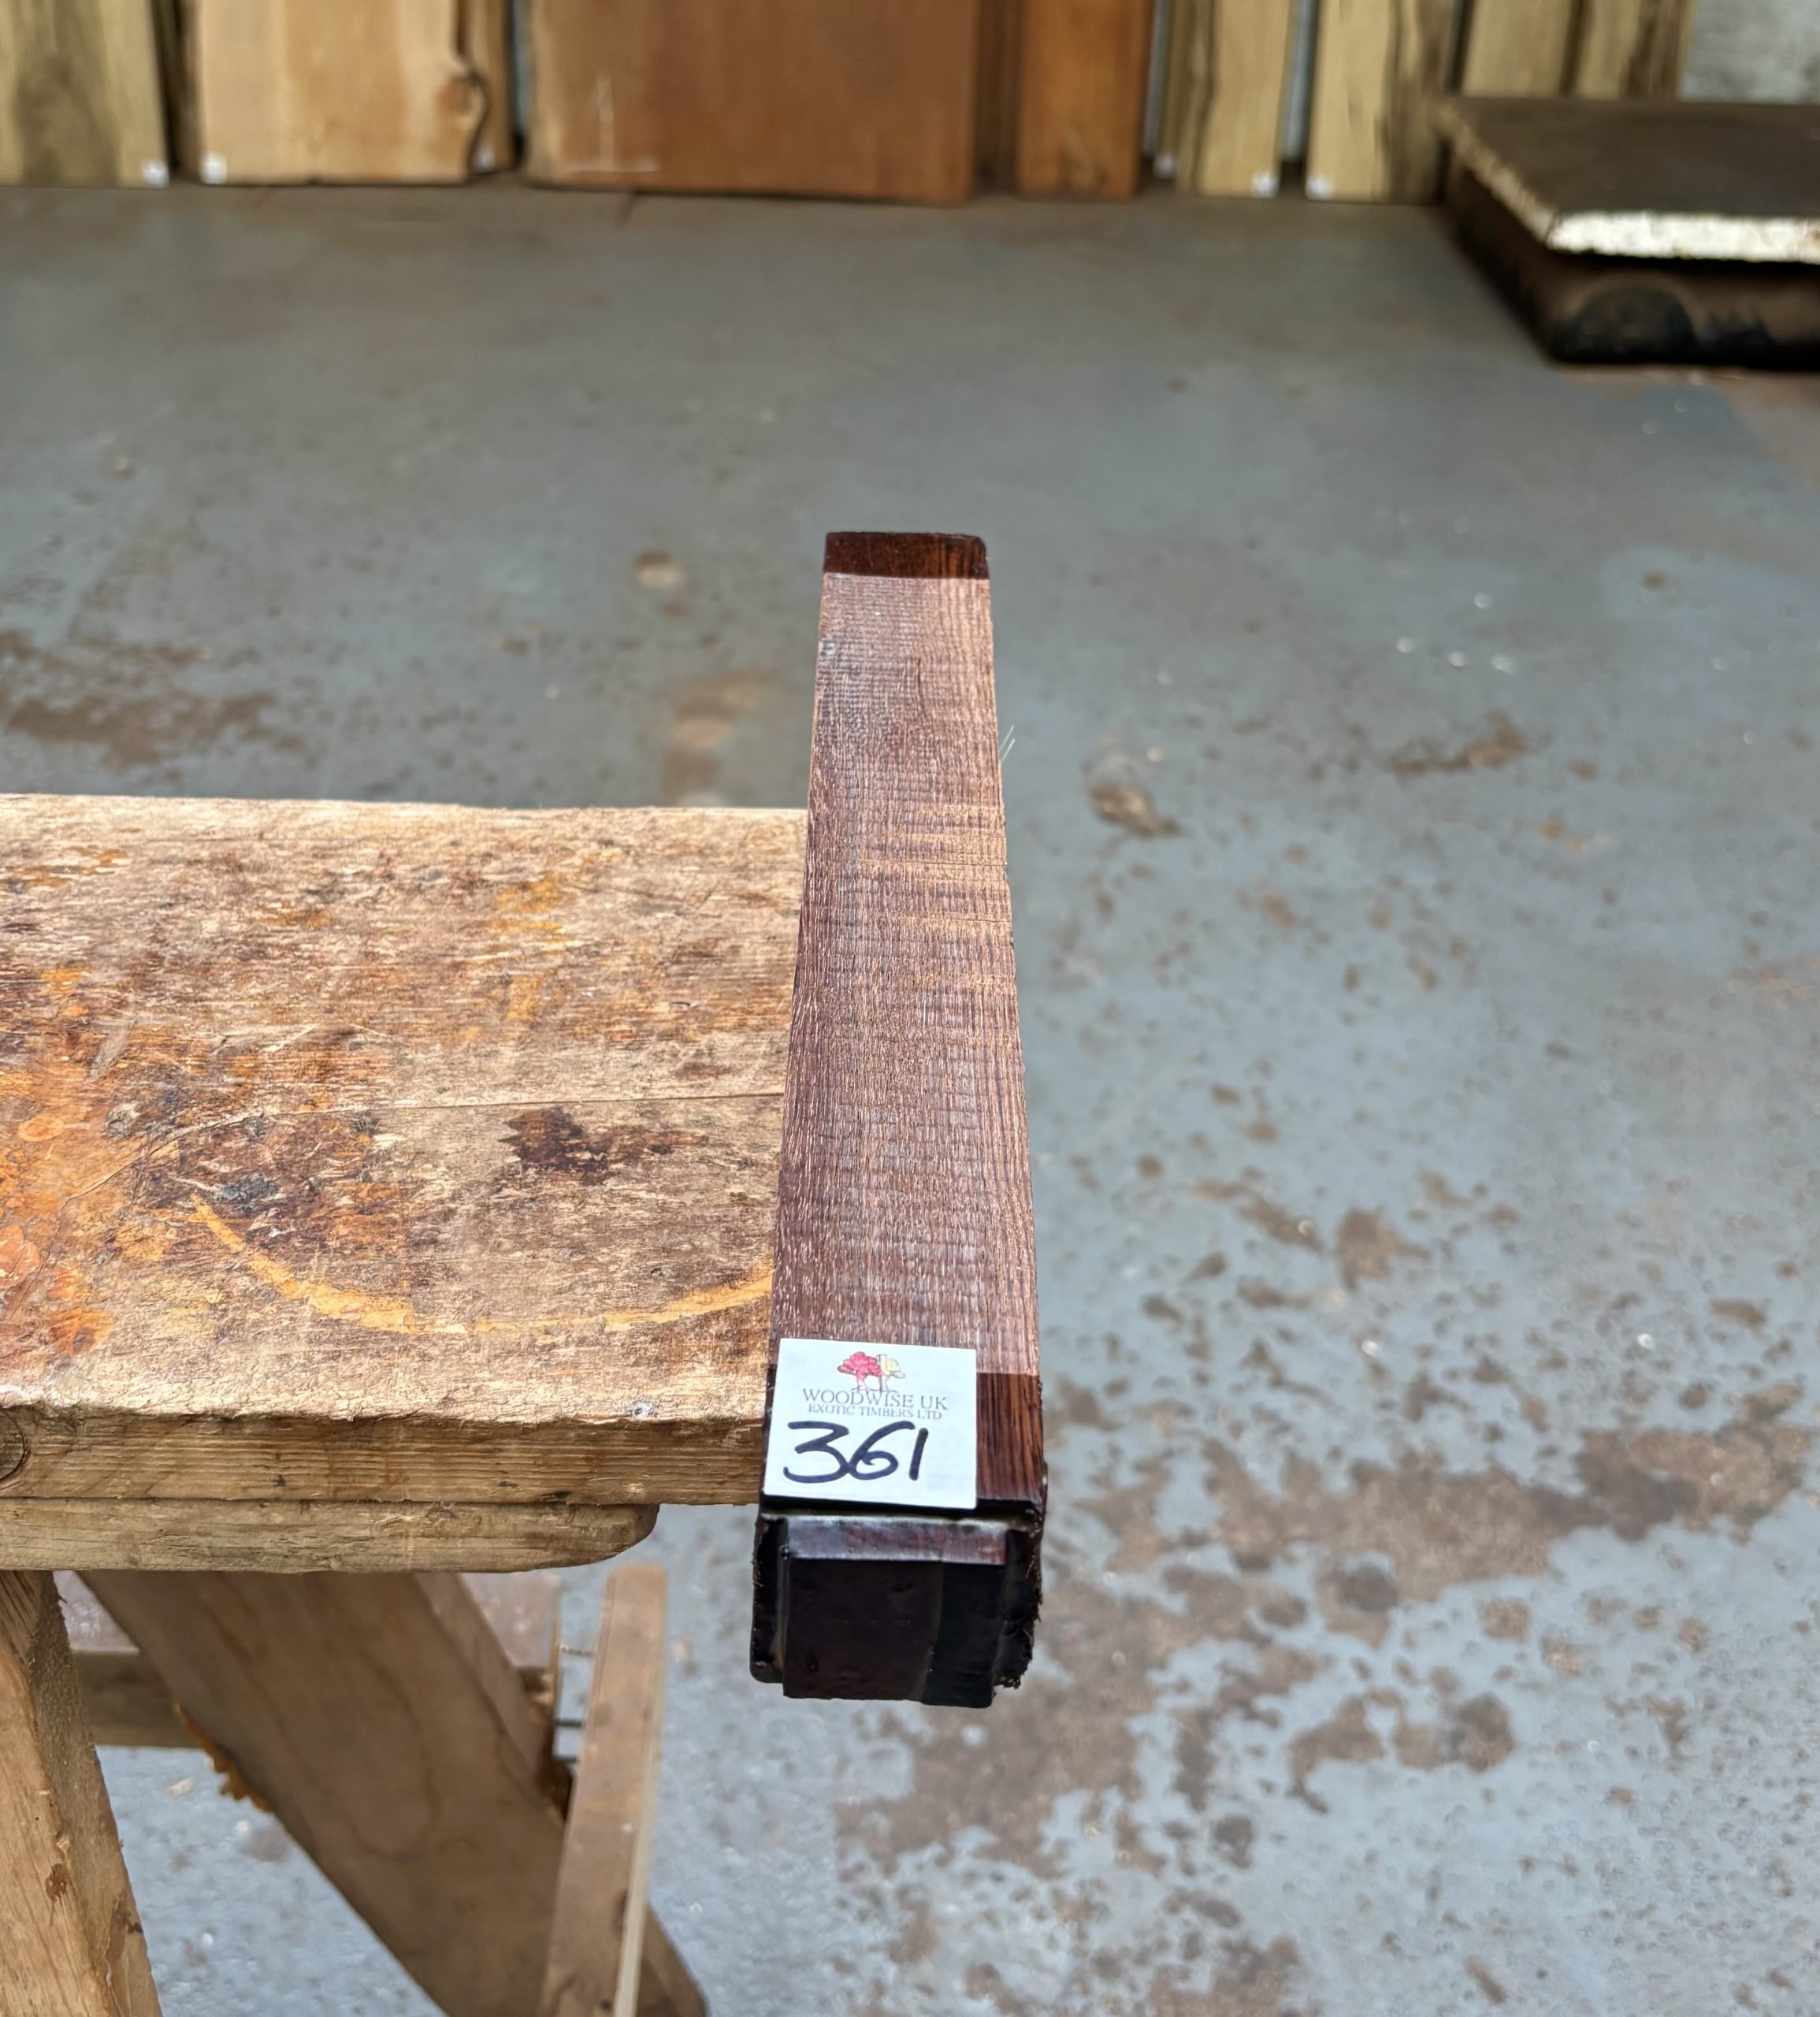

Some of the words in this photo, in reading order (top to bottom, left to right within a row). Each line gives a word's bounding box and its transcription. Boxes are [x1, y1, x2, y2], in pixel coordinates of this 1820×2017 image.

[802, 1388, 914, 1408] WOODWISE
[920, 1395, 949, 1410] UK
[808, 1403, 856, 1416] EXOTIC
[859, 1406, 914, 1418] TIMBERS
[917, 1410, 942, 1420] LTD
[783, 1421, 929, 1484] 361
